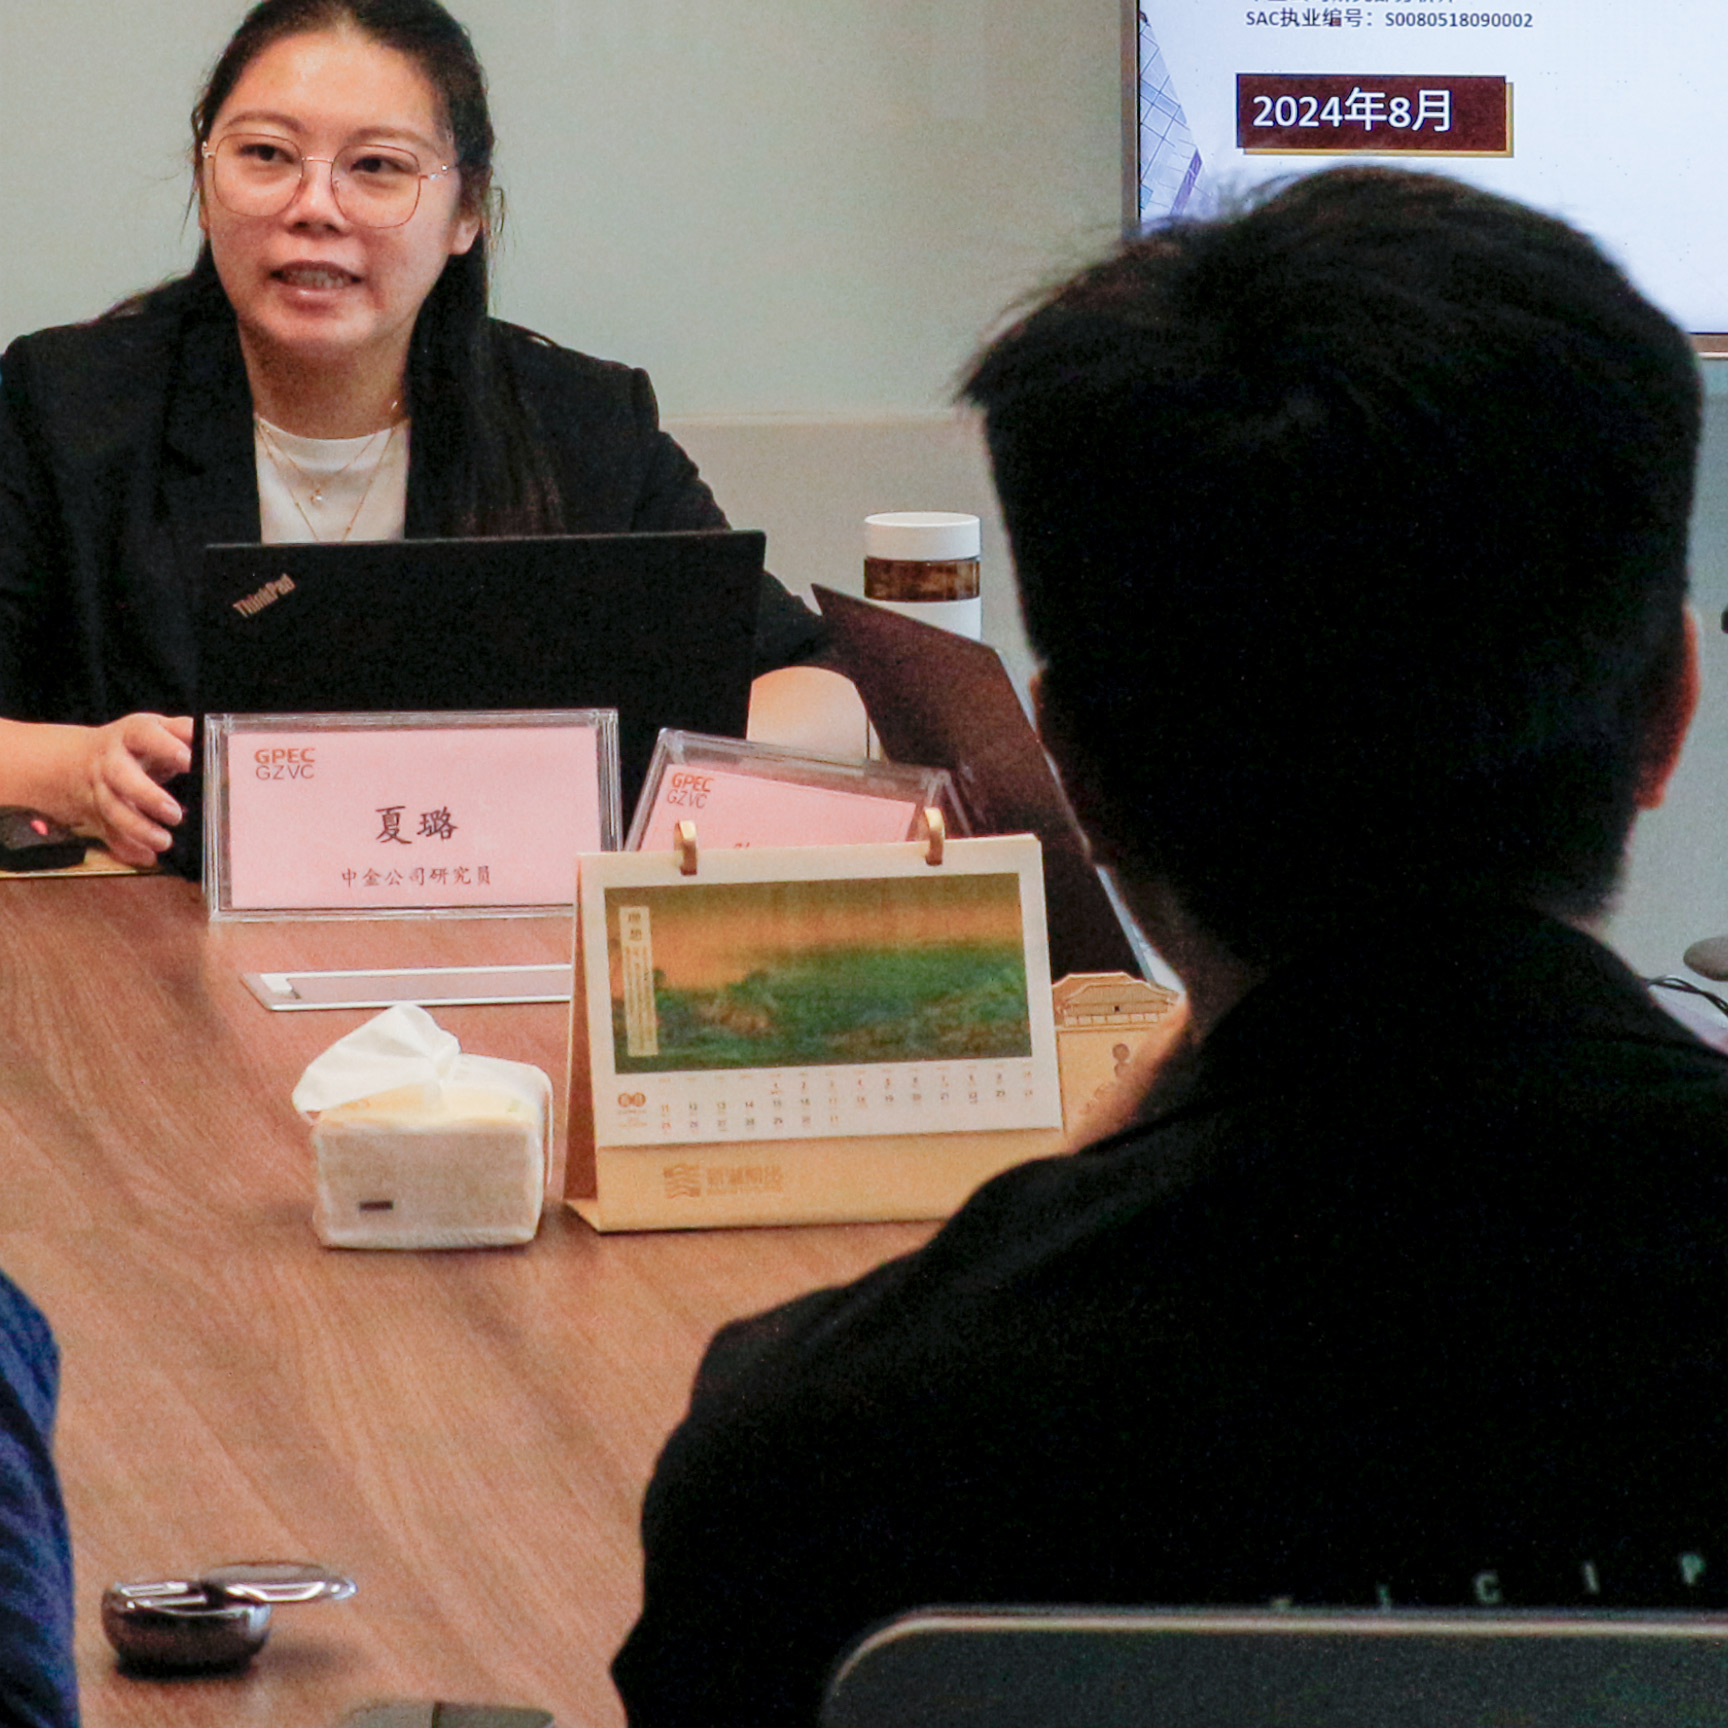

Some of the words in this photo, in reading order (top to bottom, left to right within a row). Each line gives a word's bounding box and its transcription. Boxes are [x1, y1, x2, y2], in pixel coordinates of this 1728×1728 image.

[1253, 87, 1450, 132] 2024年8月
[254, 748, 315, 764] GPEC
[254, 764, 315, 780] GZVC
[672, 772, 714, 793] GPEC
[375, 805, 458, 845] 夏璐
[341, 864, 491, 887] 中金公司研究员
